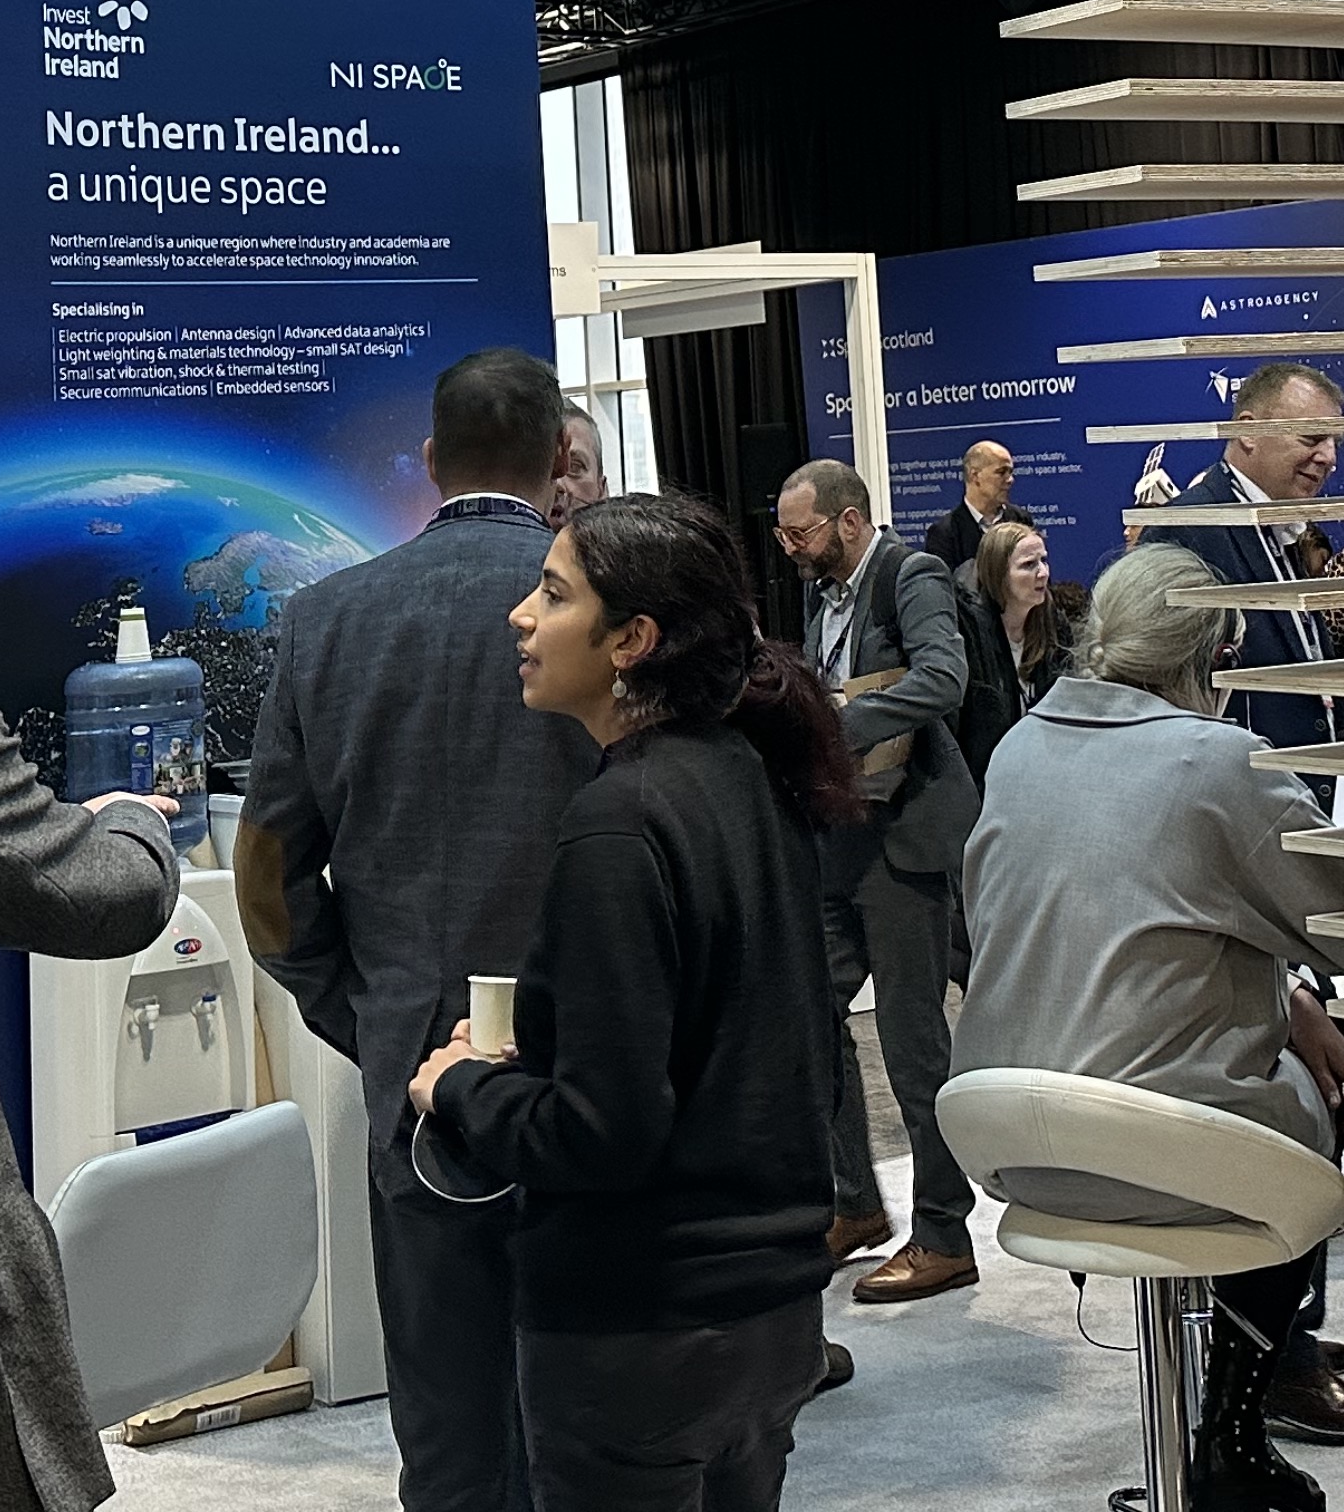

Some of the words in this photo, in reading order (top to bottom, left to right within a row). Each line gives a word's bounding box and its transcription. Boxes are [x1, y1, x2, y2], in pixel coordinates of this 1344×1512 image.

[43, 3, 91, 25] Invest
[44, 26, 145, 54] Northern
[44, 53, 120, 79] Ireland
[330, 62, 364, 89] NI
[373, 58, 462, 91] SPACE
[46, 110, 225, 151] Northern
[234, 117, 401, 155] Ireland...
[47, 172, 69, 200] a
[79, 164, 212, 214] unique
[220, 176, 327, 215] space
[50, 234, 107, 249] Northern
[109, 234, 153, 249] Ireland
[155, 234, 165, 249] is
[166, 238, 174, 249] a
[176, 234, 219, 252] unique
[220, 235, 258, 253] region
[260, 235, 297, 249] where
[298, 234, 347, 253] industry
[348, 235, 372, 249] and
[373, 234, 431, 249] academia
[431, 238, 451, 249] are
[50, 252, 101, 270] working
[102, 253, 170, 270] seamlessly
[171, 253, 185, 267] to
[186, 253, 248, 267] accelerate
[249, 255, 285, 270] space
[286, 253, 352, 270] technology
[353, 252, 419, 267] innovation.
[52, 301, 130, 320] Specialising
[131, 301, 144, 316] in
[1221, 291, 1319, 311] ASTROAGENCY
[58, 328, 105, 343] Electric
[106, 328, 172, 346] propulsion
[181, 328, 233, 341] Antenna
[234, 326, 276, 343] design
[284, 325, 342, 339] Advanced
[343, 324, 371, 338] data
[372, 323, 425, 339] analytics
[58, 347, 91, 365] Light
[93, 347, 155, 365] weighting
[157, 346, 168, 360] &
[169, 345, 227, 360] materials
[228, 344, 296, 361] technology
[306, 342, 338, 357] small
[340, 342, 362, 356] SAT
[363, 341, 403, 358] design
[59, 366, 94, 381] Small
[95, 367, 116, 380] sat
[117, 365, 178, 380] vibration,
[179, 364, 214, 378] shock
[216, 363, 226, 377] &
[227, 362, 276, 376] thermal
[277, 361, 319, 378] testing
[60, 386, 102, 400] Secure
[104, 382, 208, 398] communications
[216, 380, 282, 396] Embedded
[283, 381, 330, 393] sensors
[921, 383, 977, 406] better
[981, 376, 1077, 400] tomorrow
